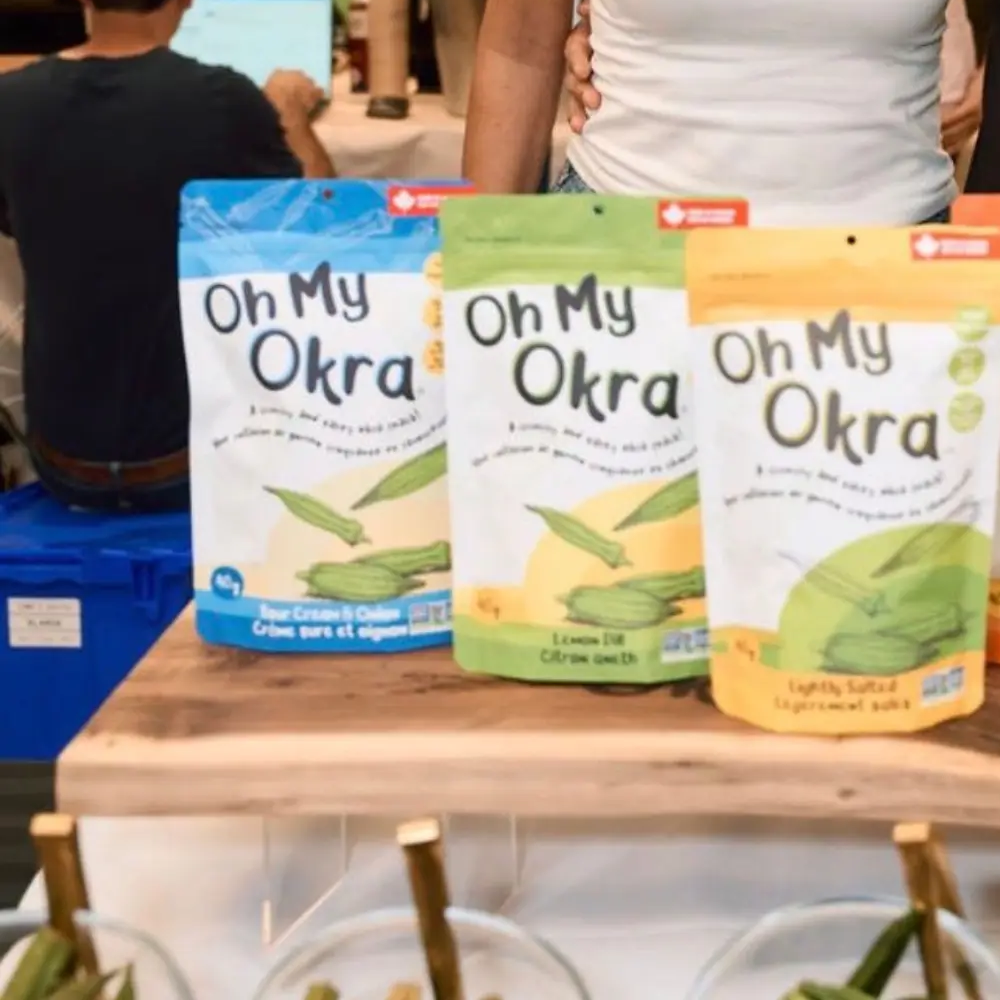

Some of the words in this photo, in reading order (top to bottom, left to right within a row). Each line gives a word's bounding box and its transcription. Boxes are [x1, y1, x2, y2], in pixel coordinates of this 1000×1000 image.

[205, 278, 277, 335] Oh
[288, 260, 370, 323] My
[465, 288, 543, 347] Oh
[554, 272, 636, 338] My
[251, 328, 417, 406] Okra
[513, 341, 680, 423] Okra
[713, 326, 794, 385] Oh
[805, 308, 893, 376] My
[765, 381, 940, 466] Okra
